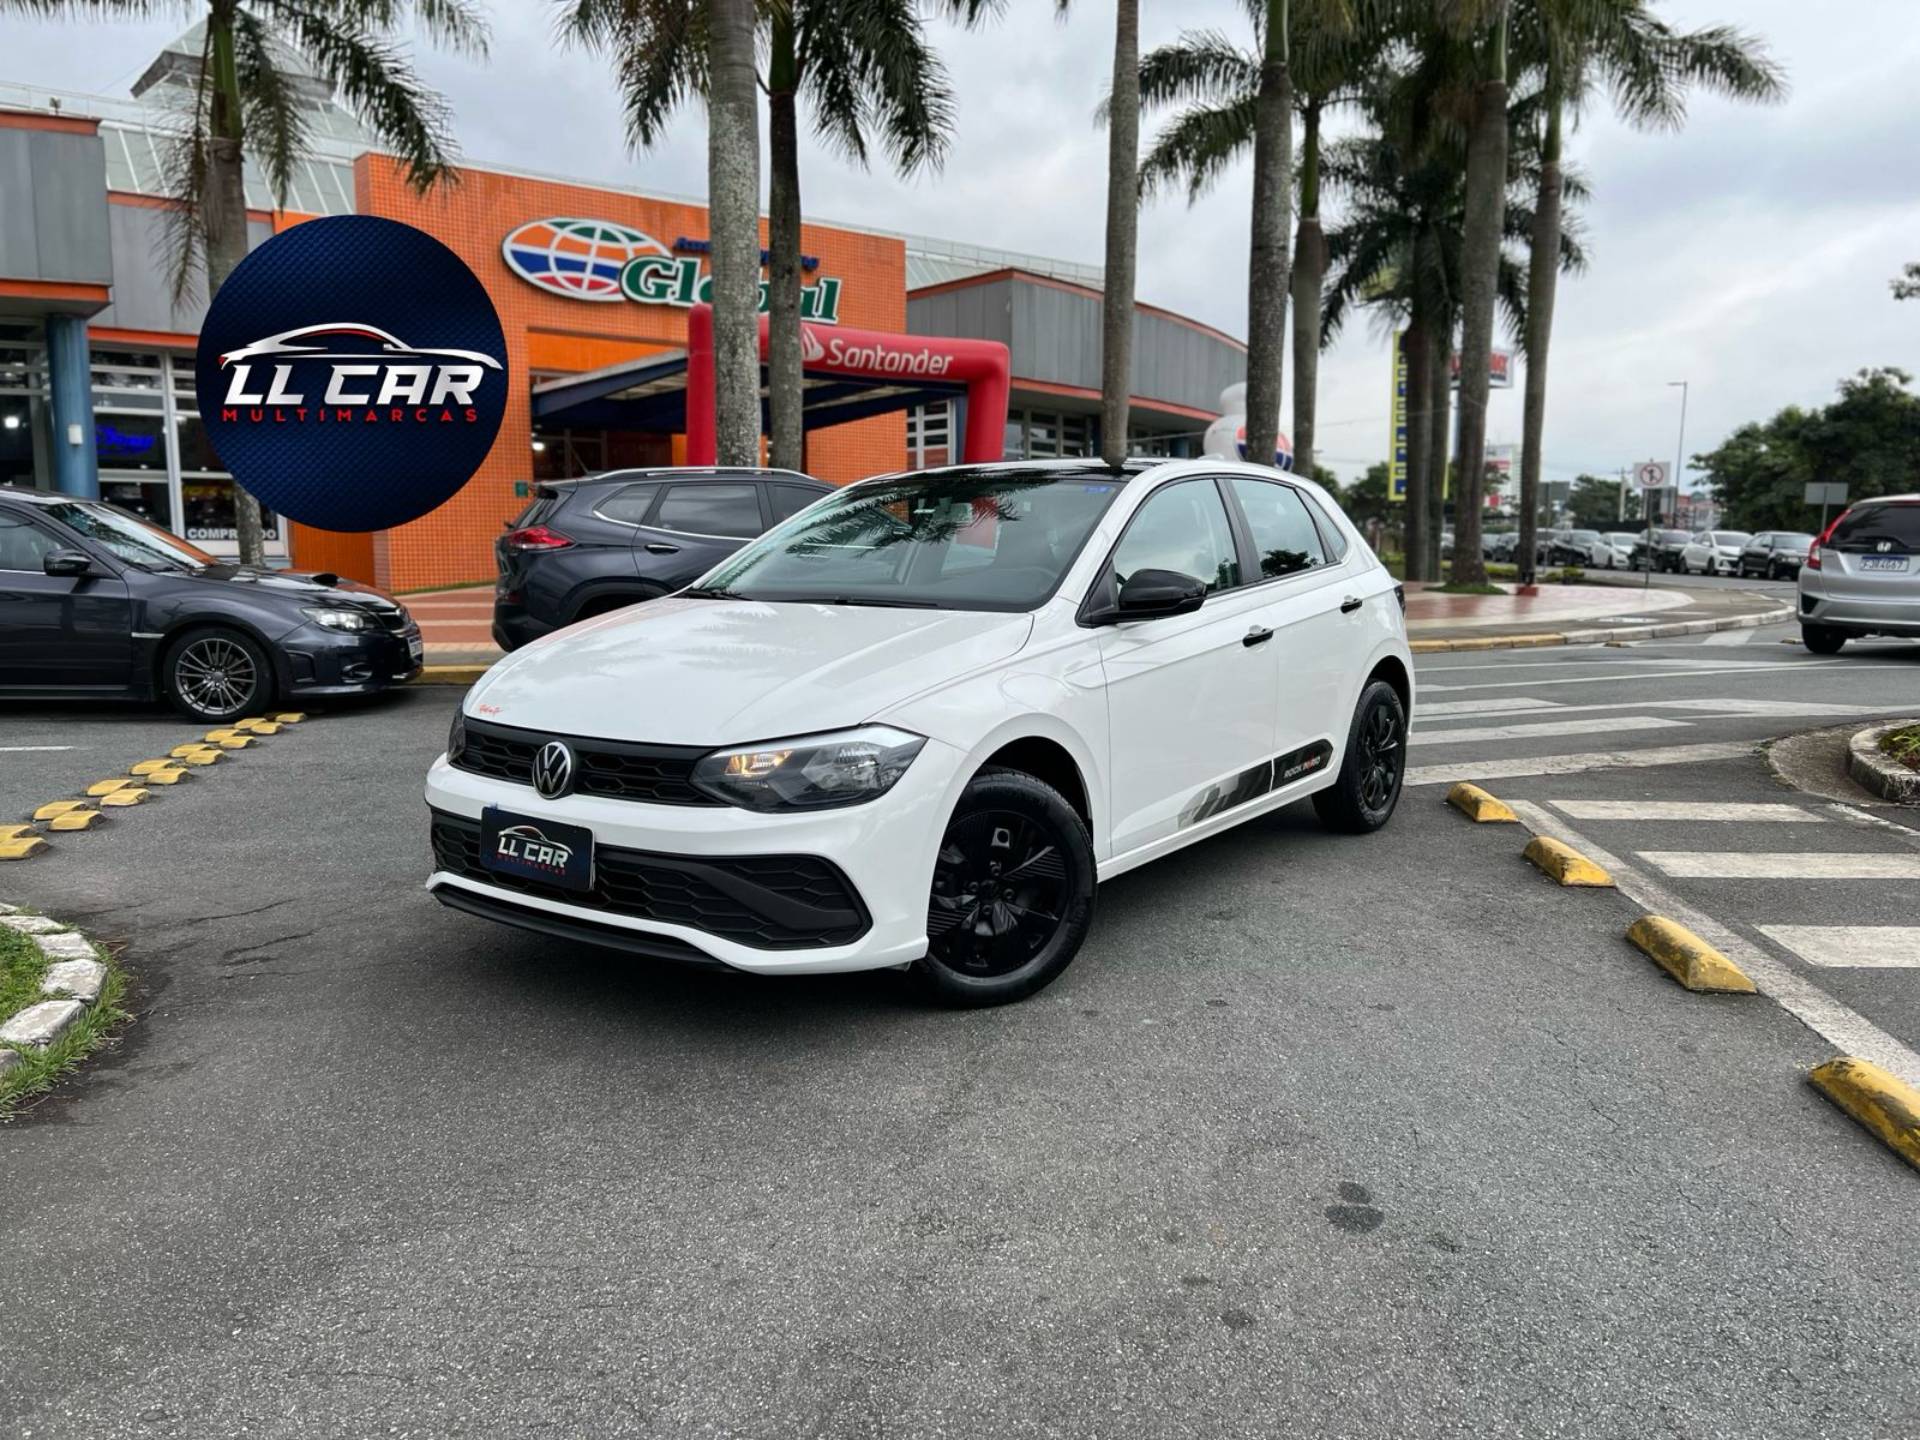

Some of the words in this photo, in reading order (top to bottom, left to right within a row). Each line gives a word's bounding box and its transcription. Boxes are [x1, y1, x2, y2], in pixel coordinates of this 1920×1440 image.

[827, 338, 953, 375] Santander
[498, 837, 518, 857] LL
[523, 843, 569, 868] CAR
